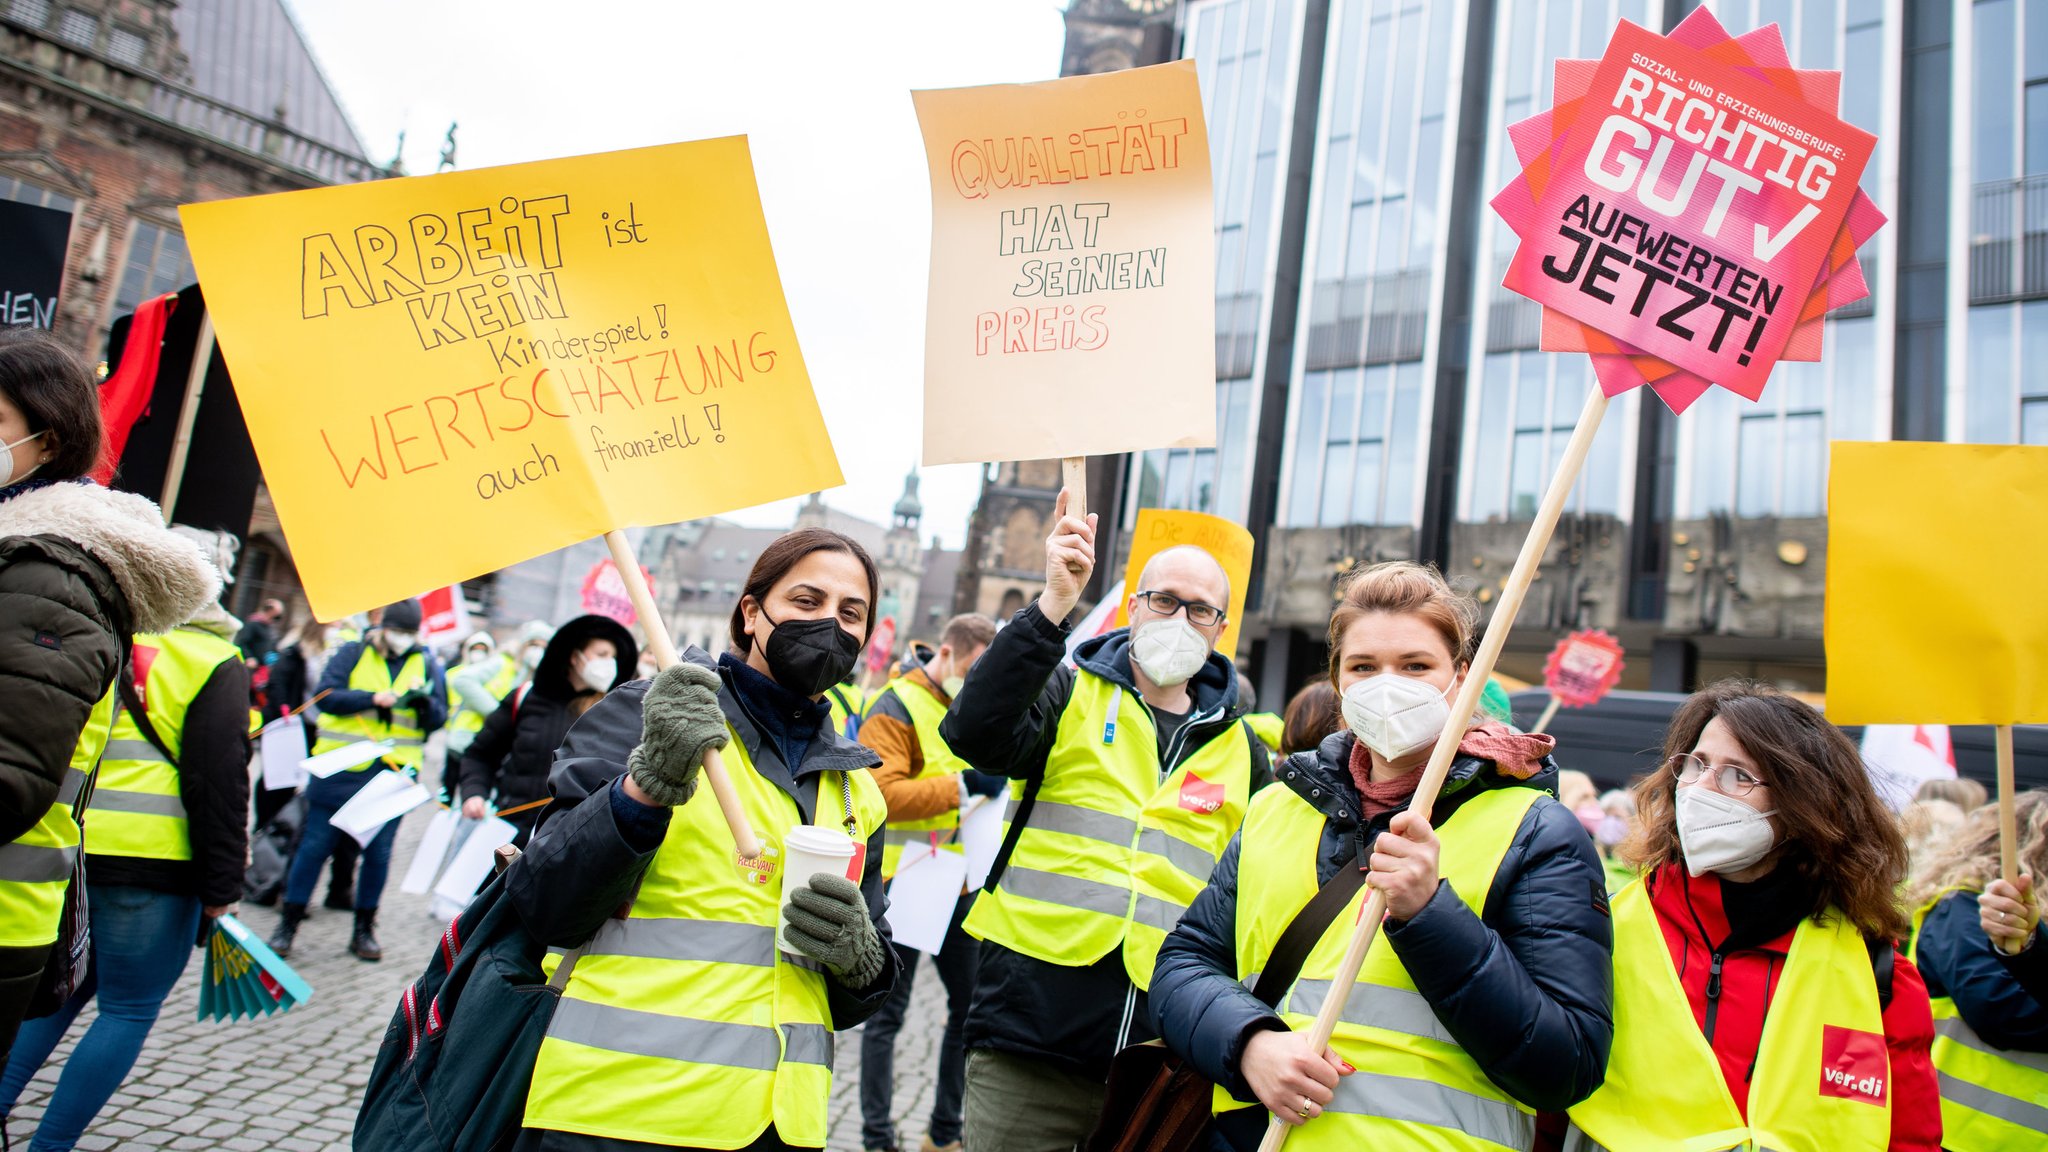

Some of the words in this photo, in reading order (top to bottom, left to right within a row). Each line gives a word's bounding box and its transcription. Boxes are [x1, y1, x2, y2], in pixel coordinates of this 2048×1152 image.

[1611, 66, 1837, 201] RICHTIG
[1630, 52, 1684, 84] SOZIAL-
[1688, 79, 1714, 99] UND
[1715, 92, 1846, 161] ERZIEHUNGSBERUFE:
[1583, 114, 1764, 239] GUT
[601, 202, 649, 248] ist
[999, 202, 1110, 257] HAT
[1561, 194, 1784, 315] AUFWERTEN
[1541, 225, 1769, 368] JETZT!
[319, 330, 778, 489] WERTSCHÄTZUNG
[476, 442, 561, 500] auch
[1150, 518, 1183, 543] Die
[1181, 793, 1221, 814] ver.di
[1824, 1067, 1883, 1098] ver.di
